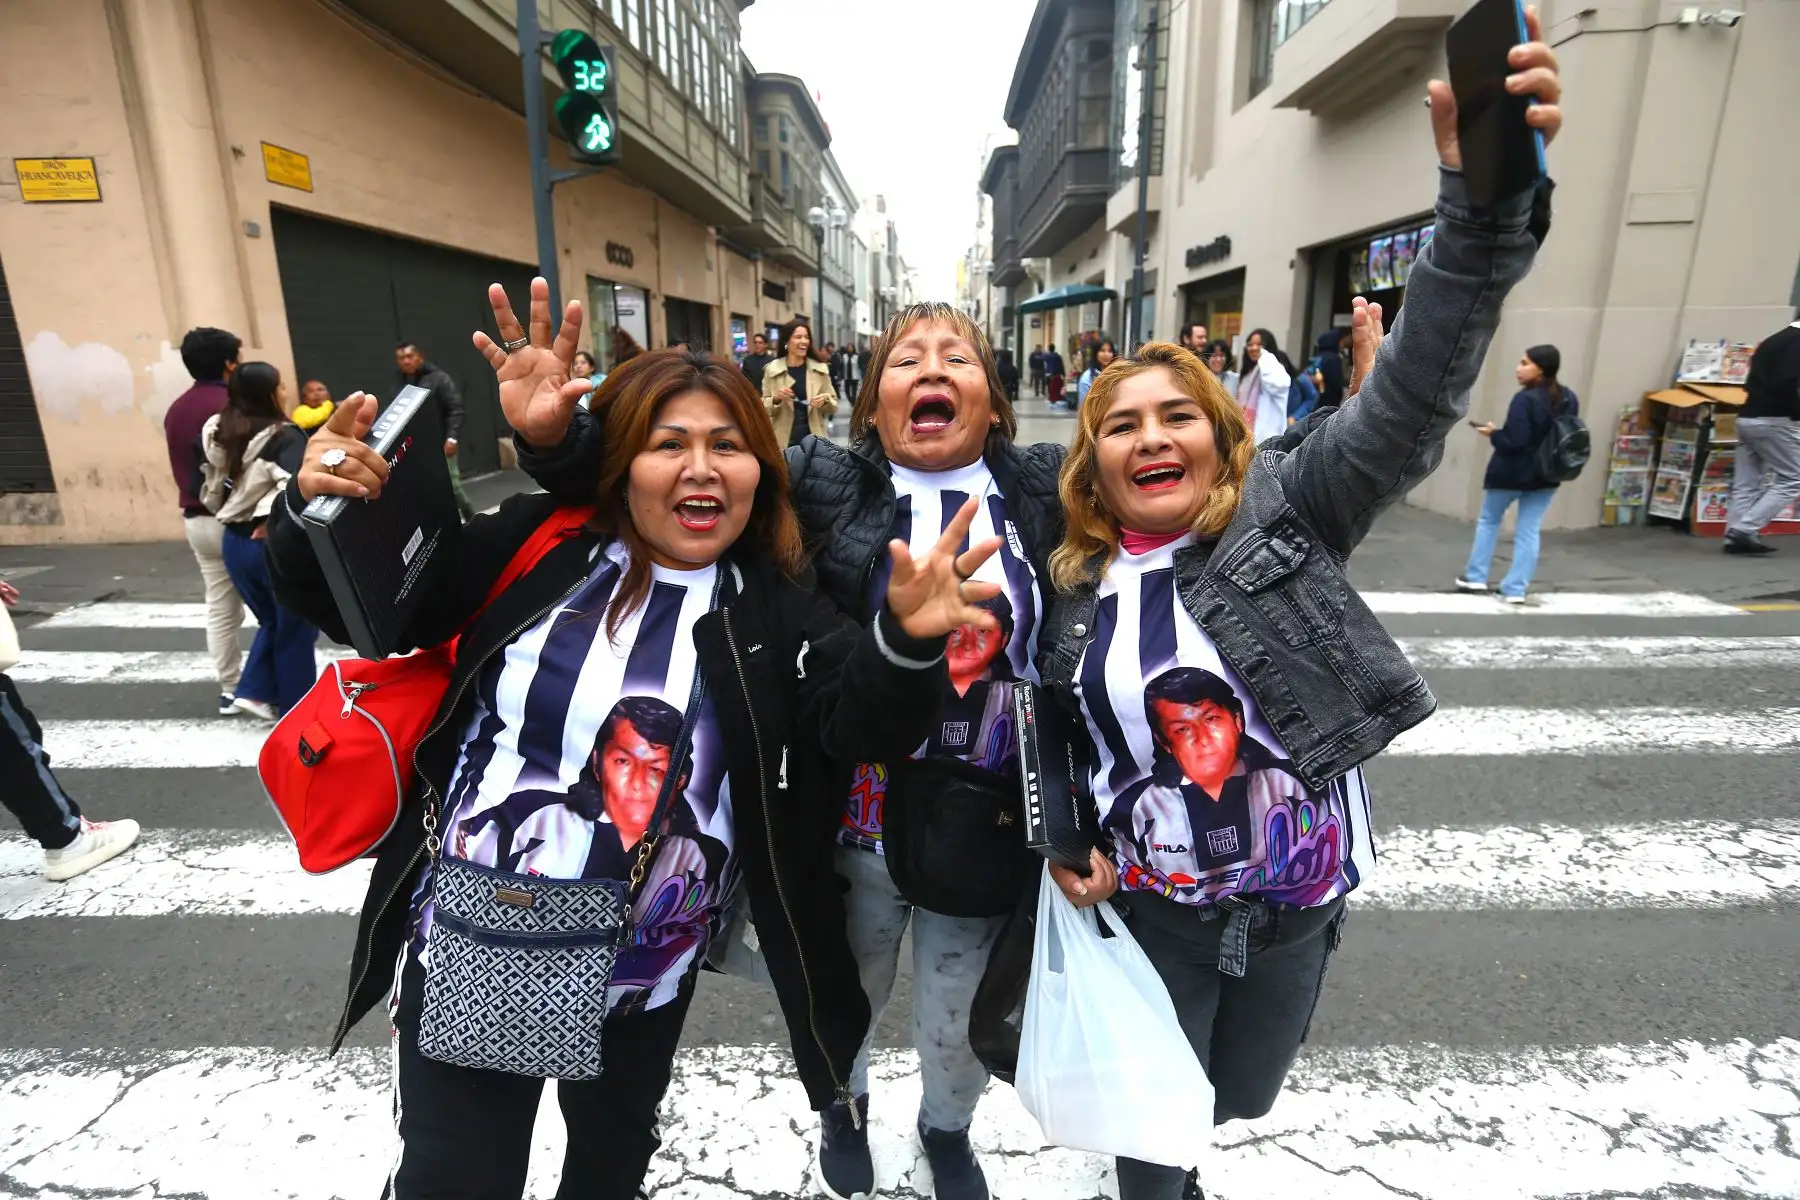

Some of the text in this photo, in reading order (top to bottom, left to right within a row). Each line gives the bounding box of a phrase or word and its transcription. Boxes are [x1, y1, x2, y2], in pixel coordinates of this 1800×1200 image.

[574, 60, 606, 90] 32
[1023, 685, 1032, 703] Rock
[1024, 703, 1033, 724] photo
[1152, 843, 1188, 853] FILA
